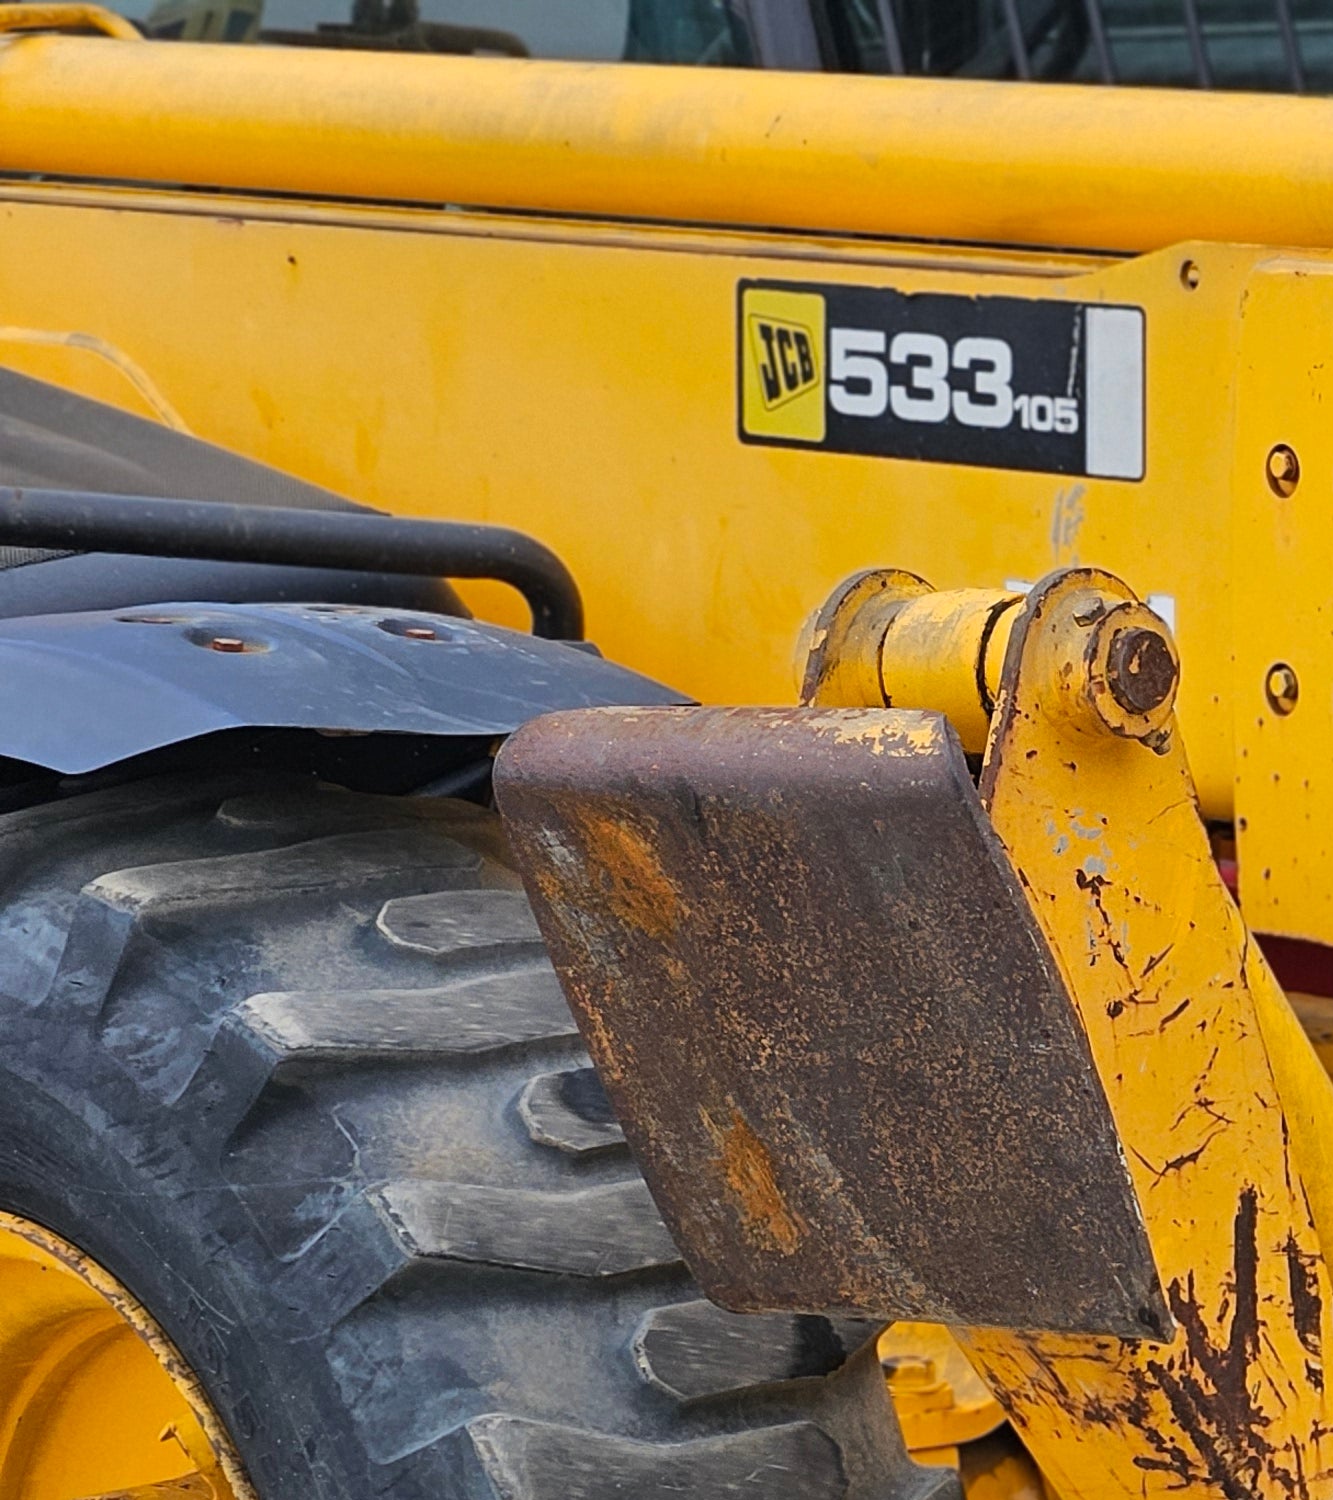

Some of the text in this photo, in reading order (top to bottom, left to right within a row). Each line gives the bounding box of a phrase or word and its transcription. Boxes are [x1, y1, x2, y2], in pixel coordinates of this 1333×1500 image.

[757, 322, 1079, 434] JCB 533 105
